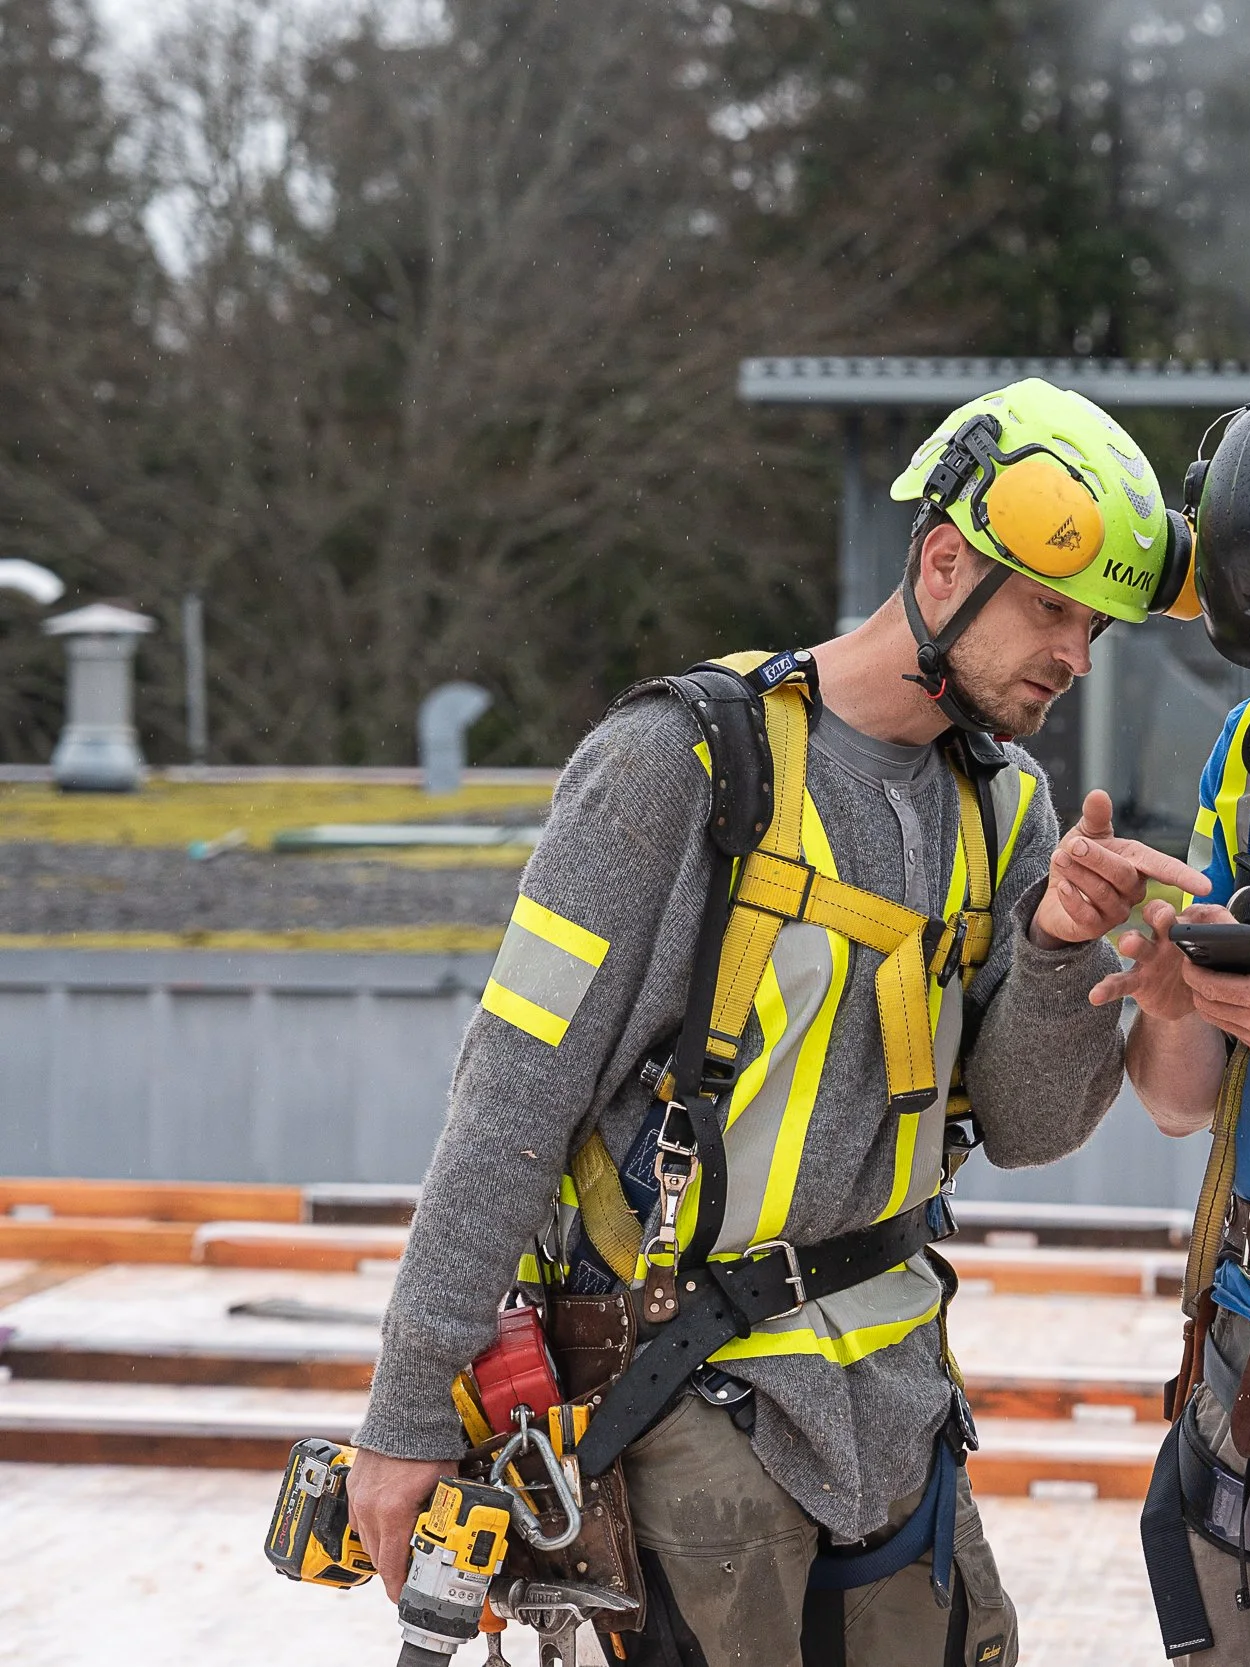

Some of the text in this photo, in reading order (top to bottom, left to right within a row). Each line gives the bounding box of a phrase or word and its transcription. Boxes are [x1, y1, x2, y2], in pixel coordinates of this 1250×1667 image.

[1103, 558, 1155, 592] KASK
[767, 659, 791, 681] SALA
[280, 1481, 300, 1548] FLEXVOLT
